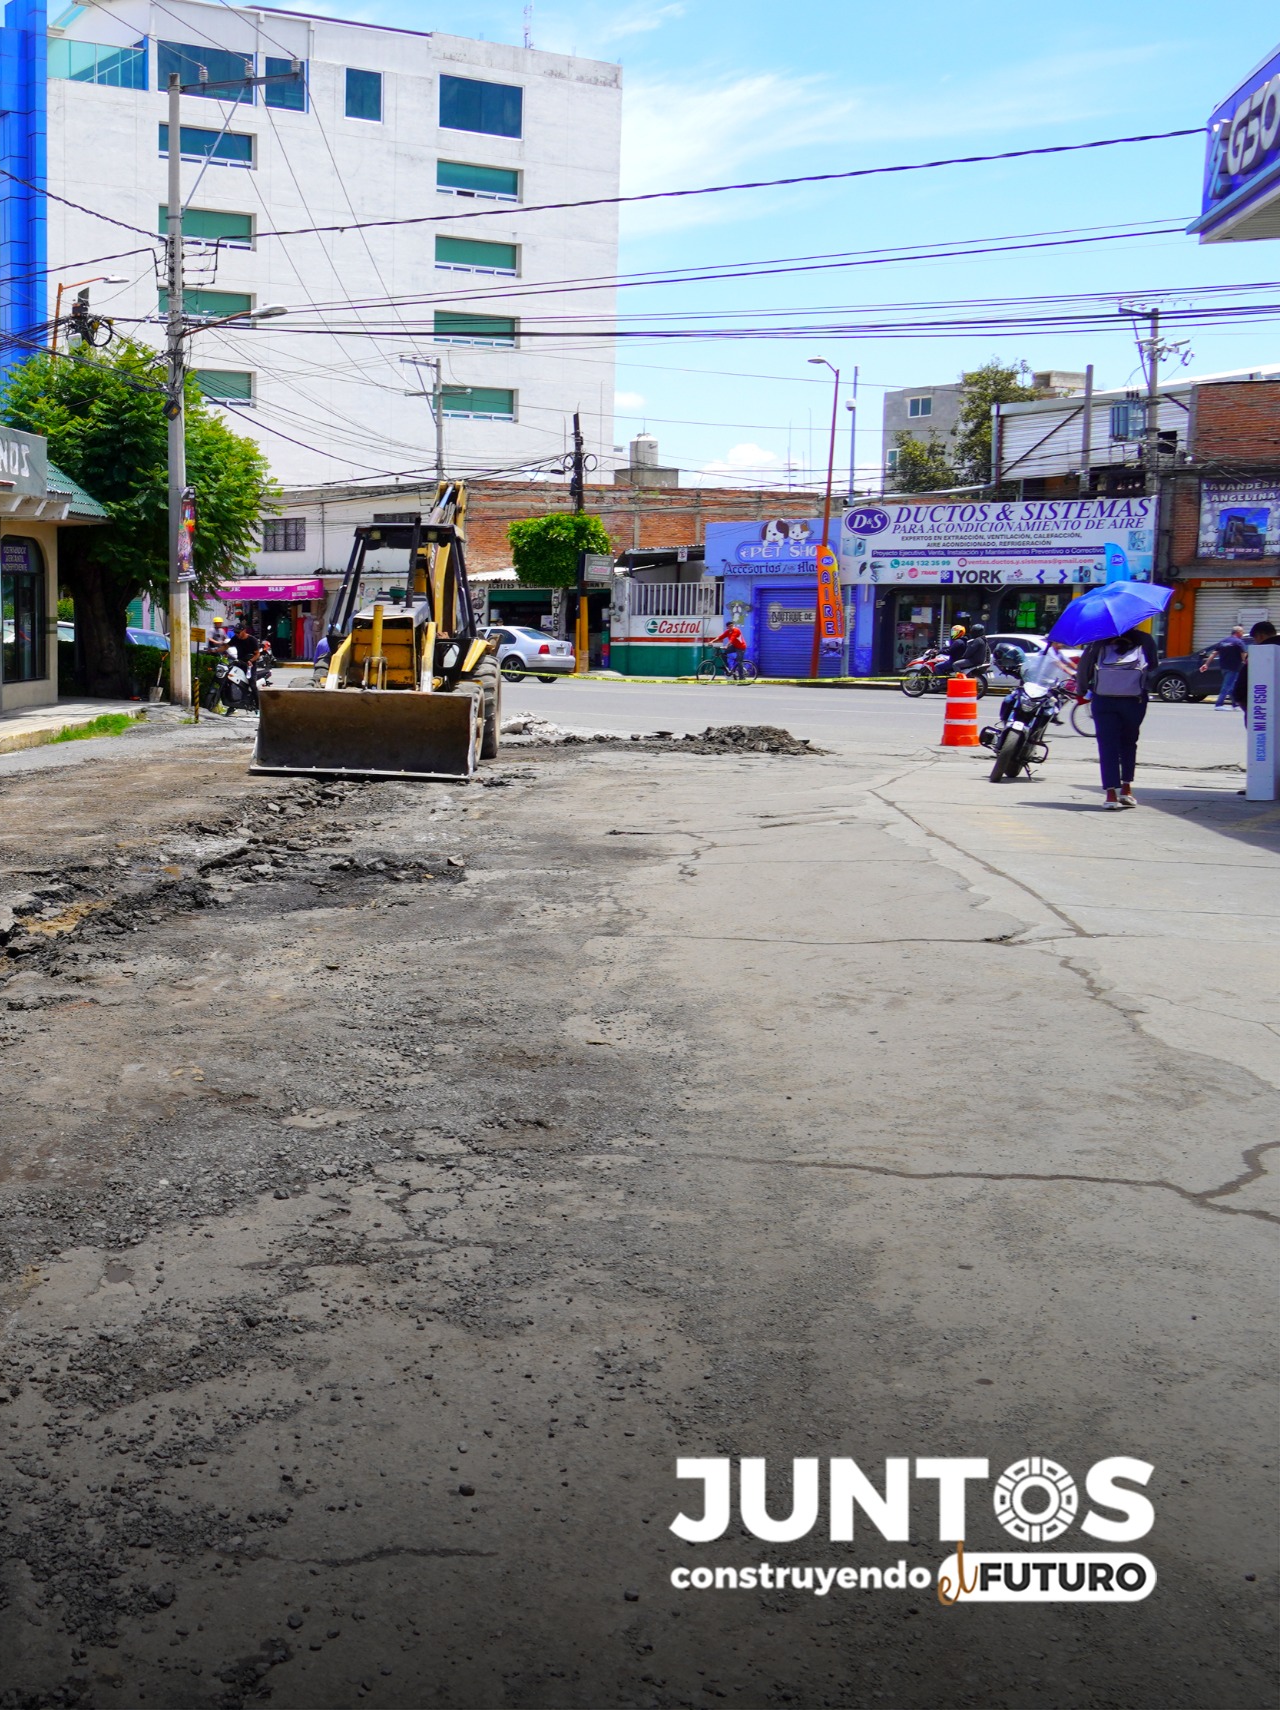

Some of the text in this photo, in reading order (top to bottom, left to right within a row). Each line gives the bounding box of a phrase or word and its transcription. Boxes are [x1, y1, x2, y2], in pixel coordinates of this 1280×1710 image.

[1211, 492, 1277, 502] ANGELINA
[894, 498, 1152, 523] DUCTOS & SISTEMAS
[852, 514, 884, 529] D&S
[892, 518, 1147, 534] PARA ACONDICIONAMIENTO DE AIRE
[750, 545, 817, 558] PET SHO
[724, 562, 781, 574] Accesorios
[956, 570, 1003, 583] YORK
[658, 620, 701, 633] Castrol
[1254, 684, 1267, 762] DESCARGA MI APP G500
